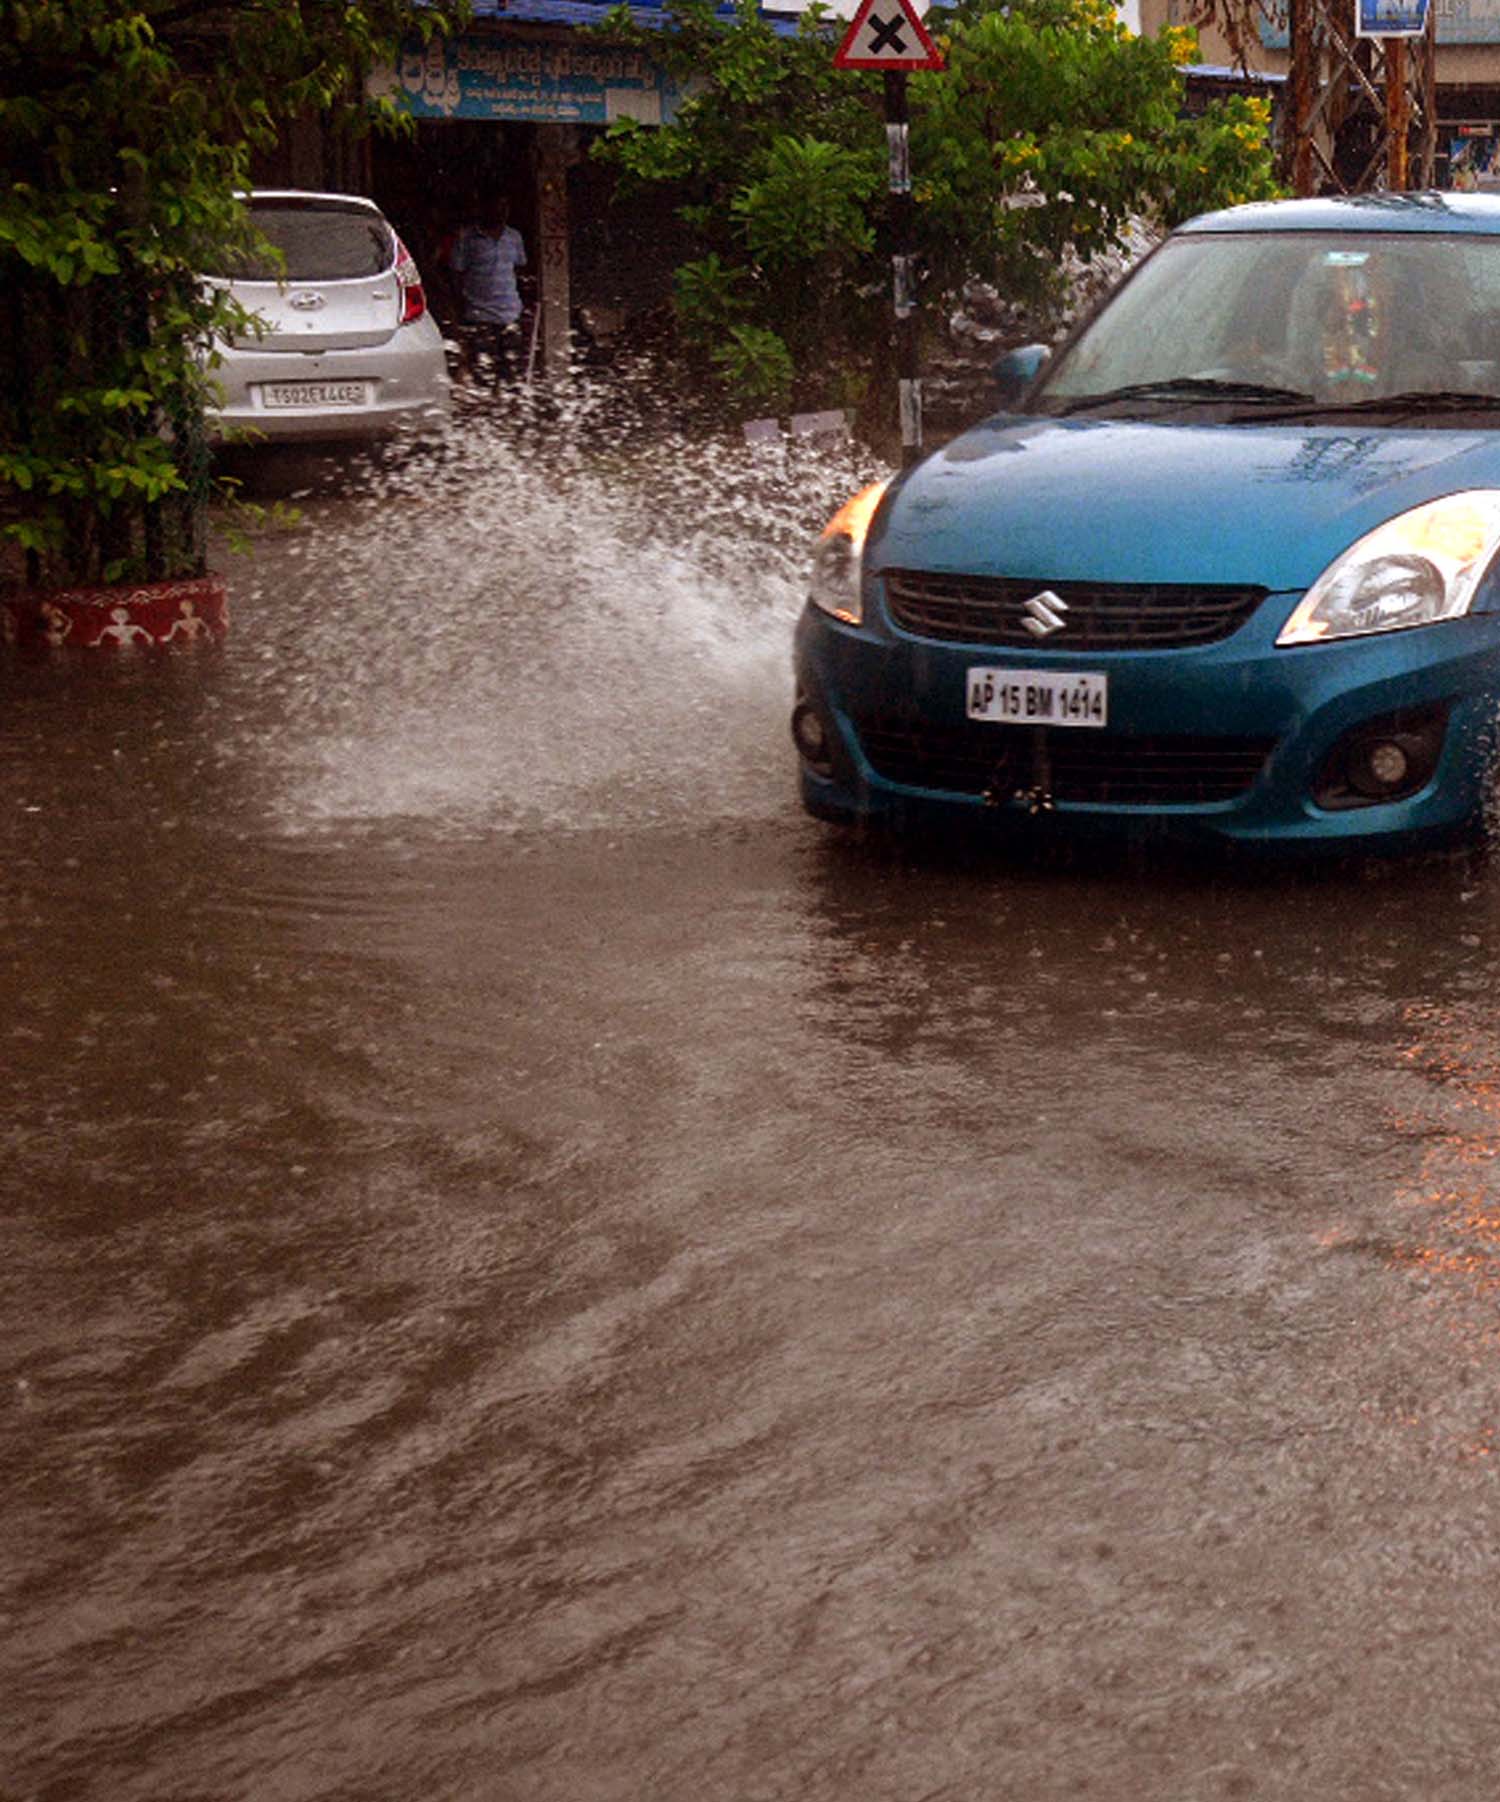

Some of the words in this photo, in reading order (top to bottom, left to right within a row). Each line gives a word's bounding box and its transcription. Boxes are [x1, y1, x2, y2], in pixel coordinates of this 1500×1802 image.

[971, 682, 993, 713] AP
[1000, 684, 1020, 715] 15
[1025, 685, 1052, 717] BM
[1060, 687, 1102, 720] 1414
